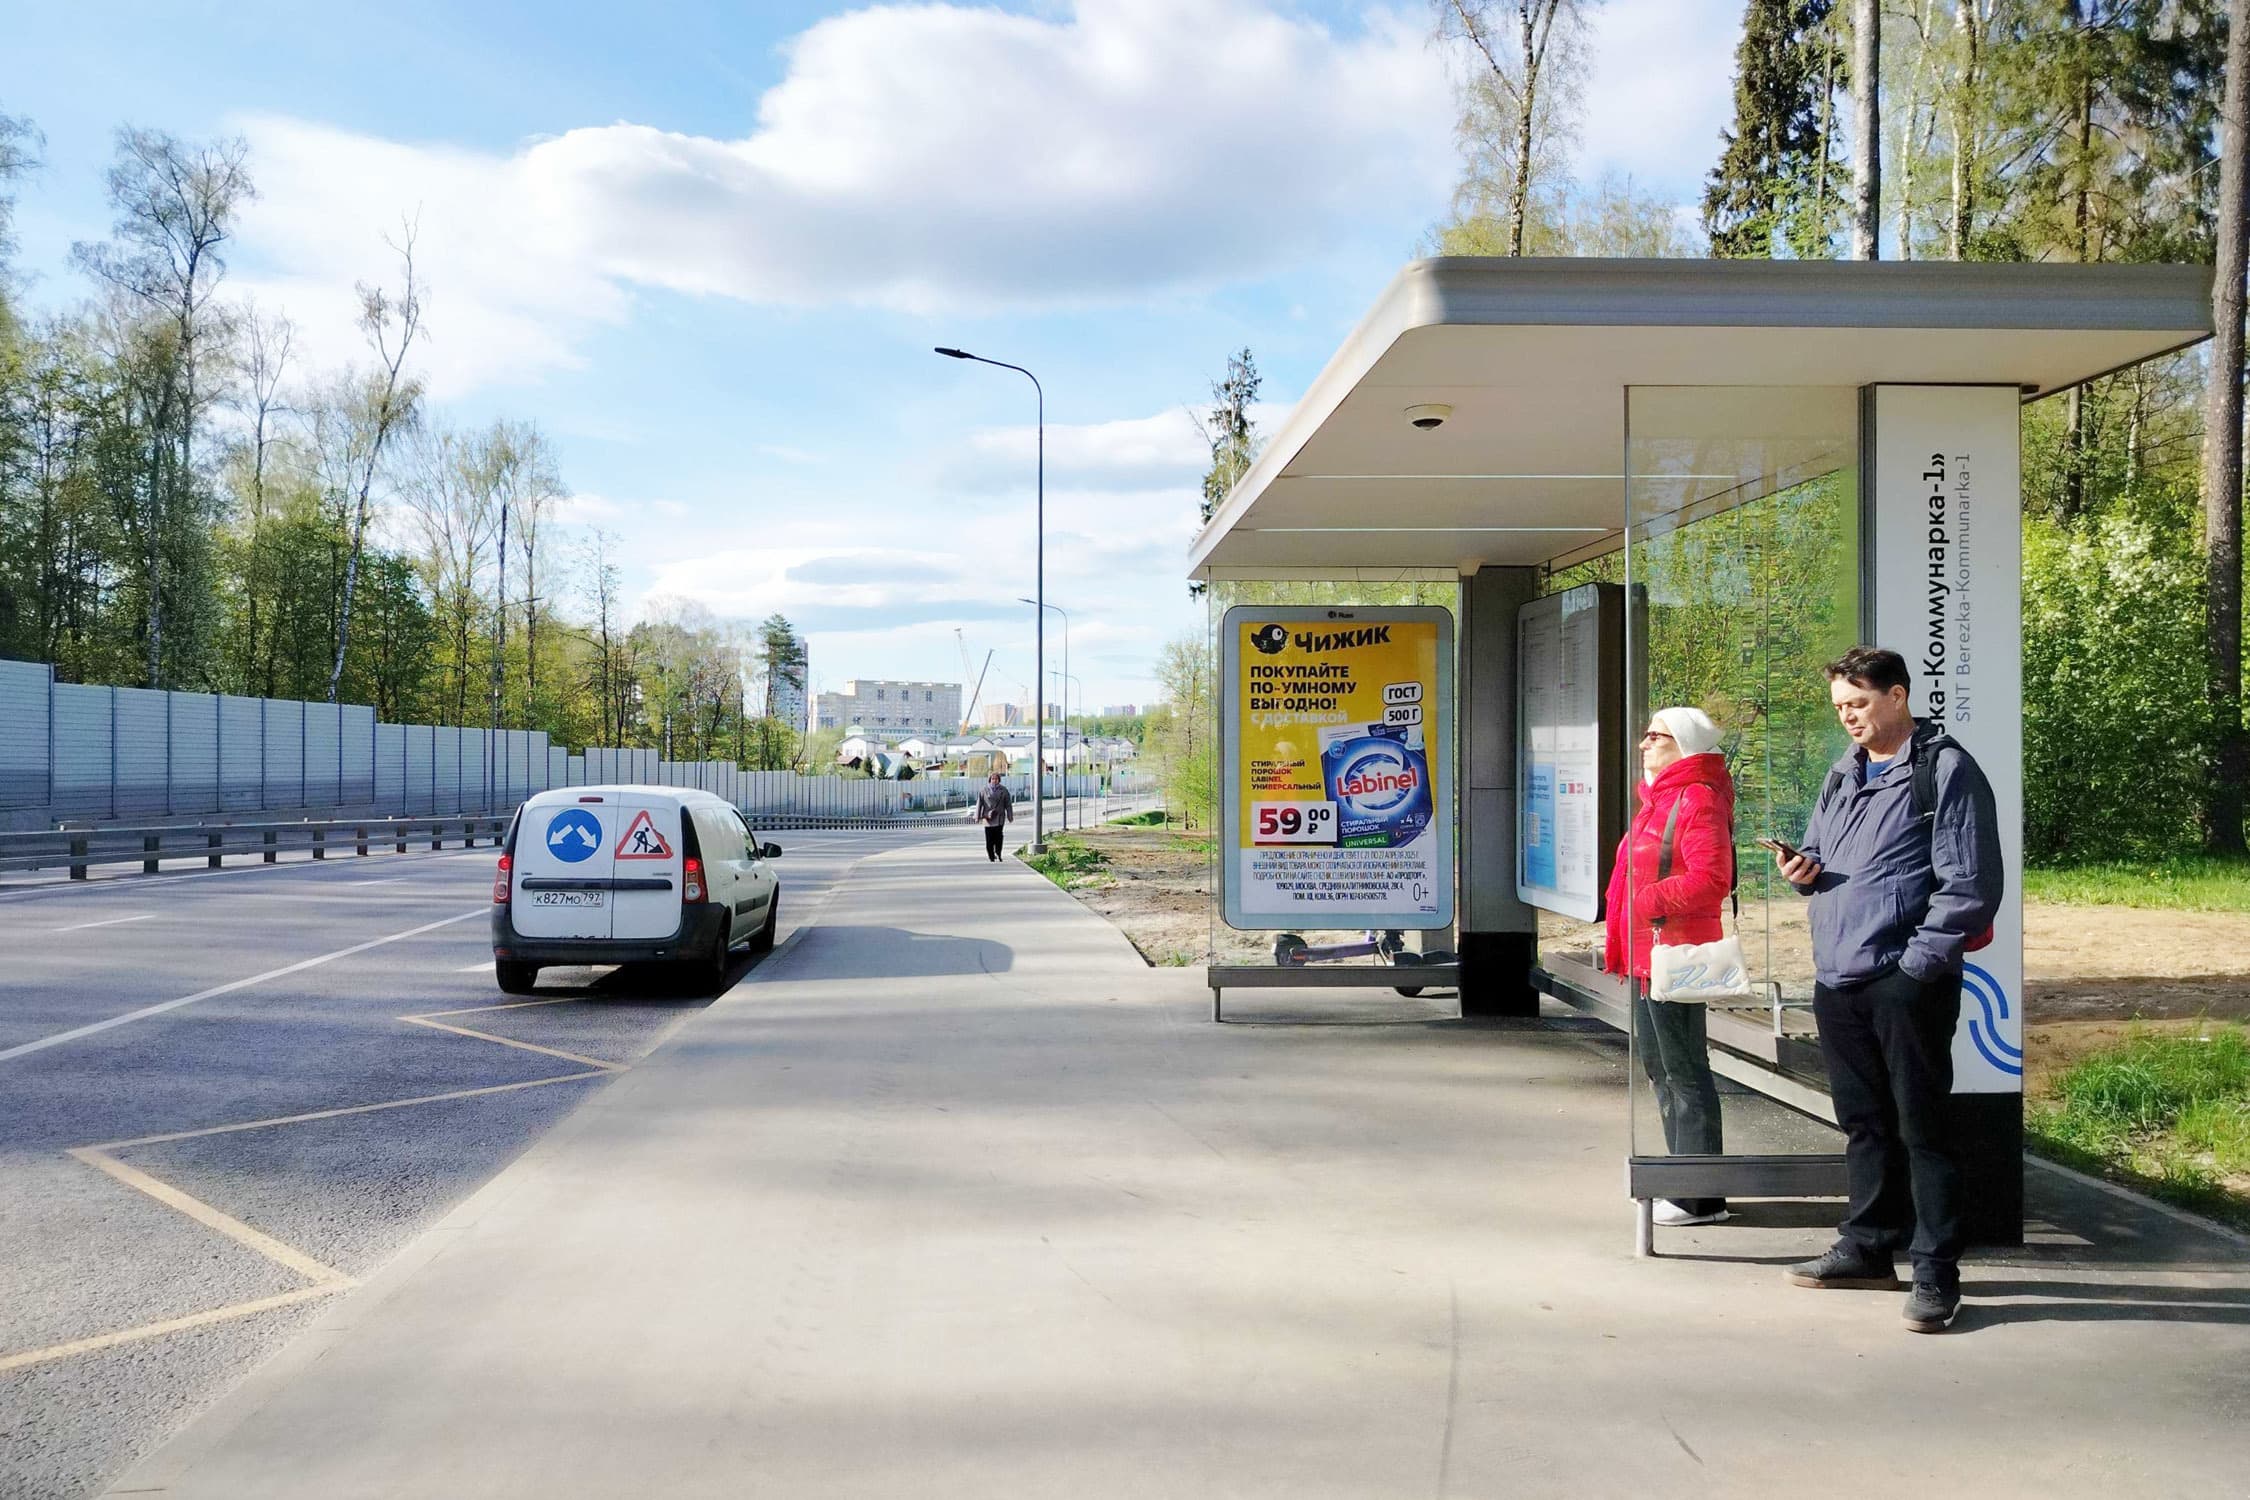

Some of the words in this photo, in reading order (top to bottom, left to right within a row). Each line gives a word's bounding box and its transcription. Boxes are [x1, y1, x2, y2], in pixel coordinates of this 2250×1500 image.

[1954, 453, 1970, 675] Berezka-Kommunarka-1
[1250, 663, 1349, 678] ПОКУПАЙТЕ
[1250, 682, 1357, 694] ПО-УМНОМУ
[1388, 686, 1416, 700] ГОСТ
[1250, 698, 1337, 712] ВЫГОДНО!
[1955, 683, 1970, 722] SNT
[1388, 710, 1410, 722] 500
[1412, 708, 1418, 720] Г
[1251, 782, 1321, 790] УНИВЕРСАЛЬНЫЙ
[1336, 767, 1418, 797] Labinel
[1259, 808, 1302, 835] 59
[1308, 808, 1330, 821] 00
[1341, 824, 1380, 834] ПОРОШОК
[1412, 882, 1429, 902] 0+
